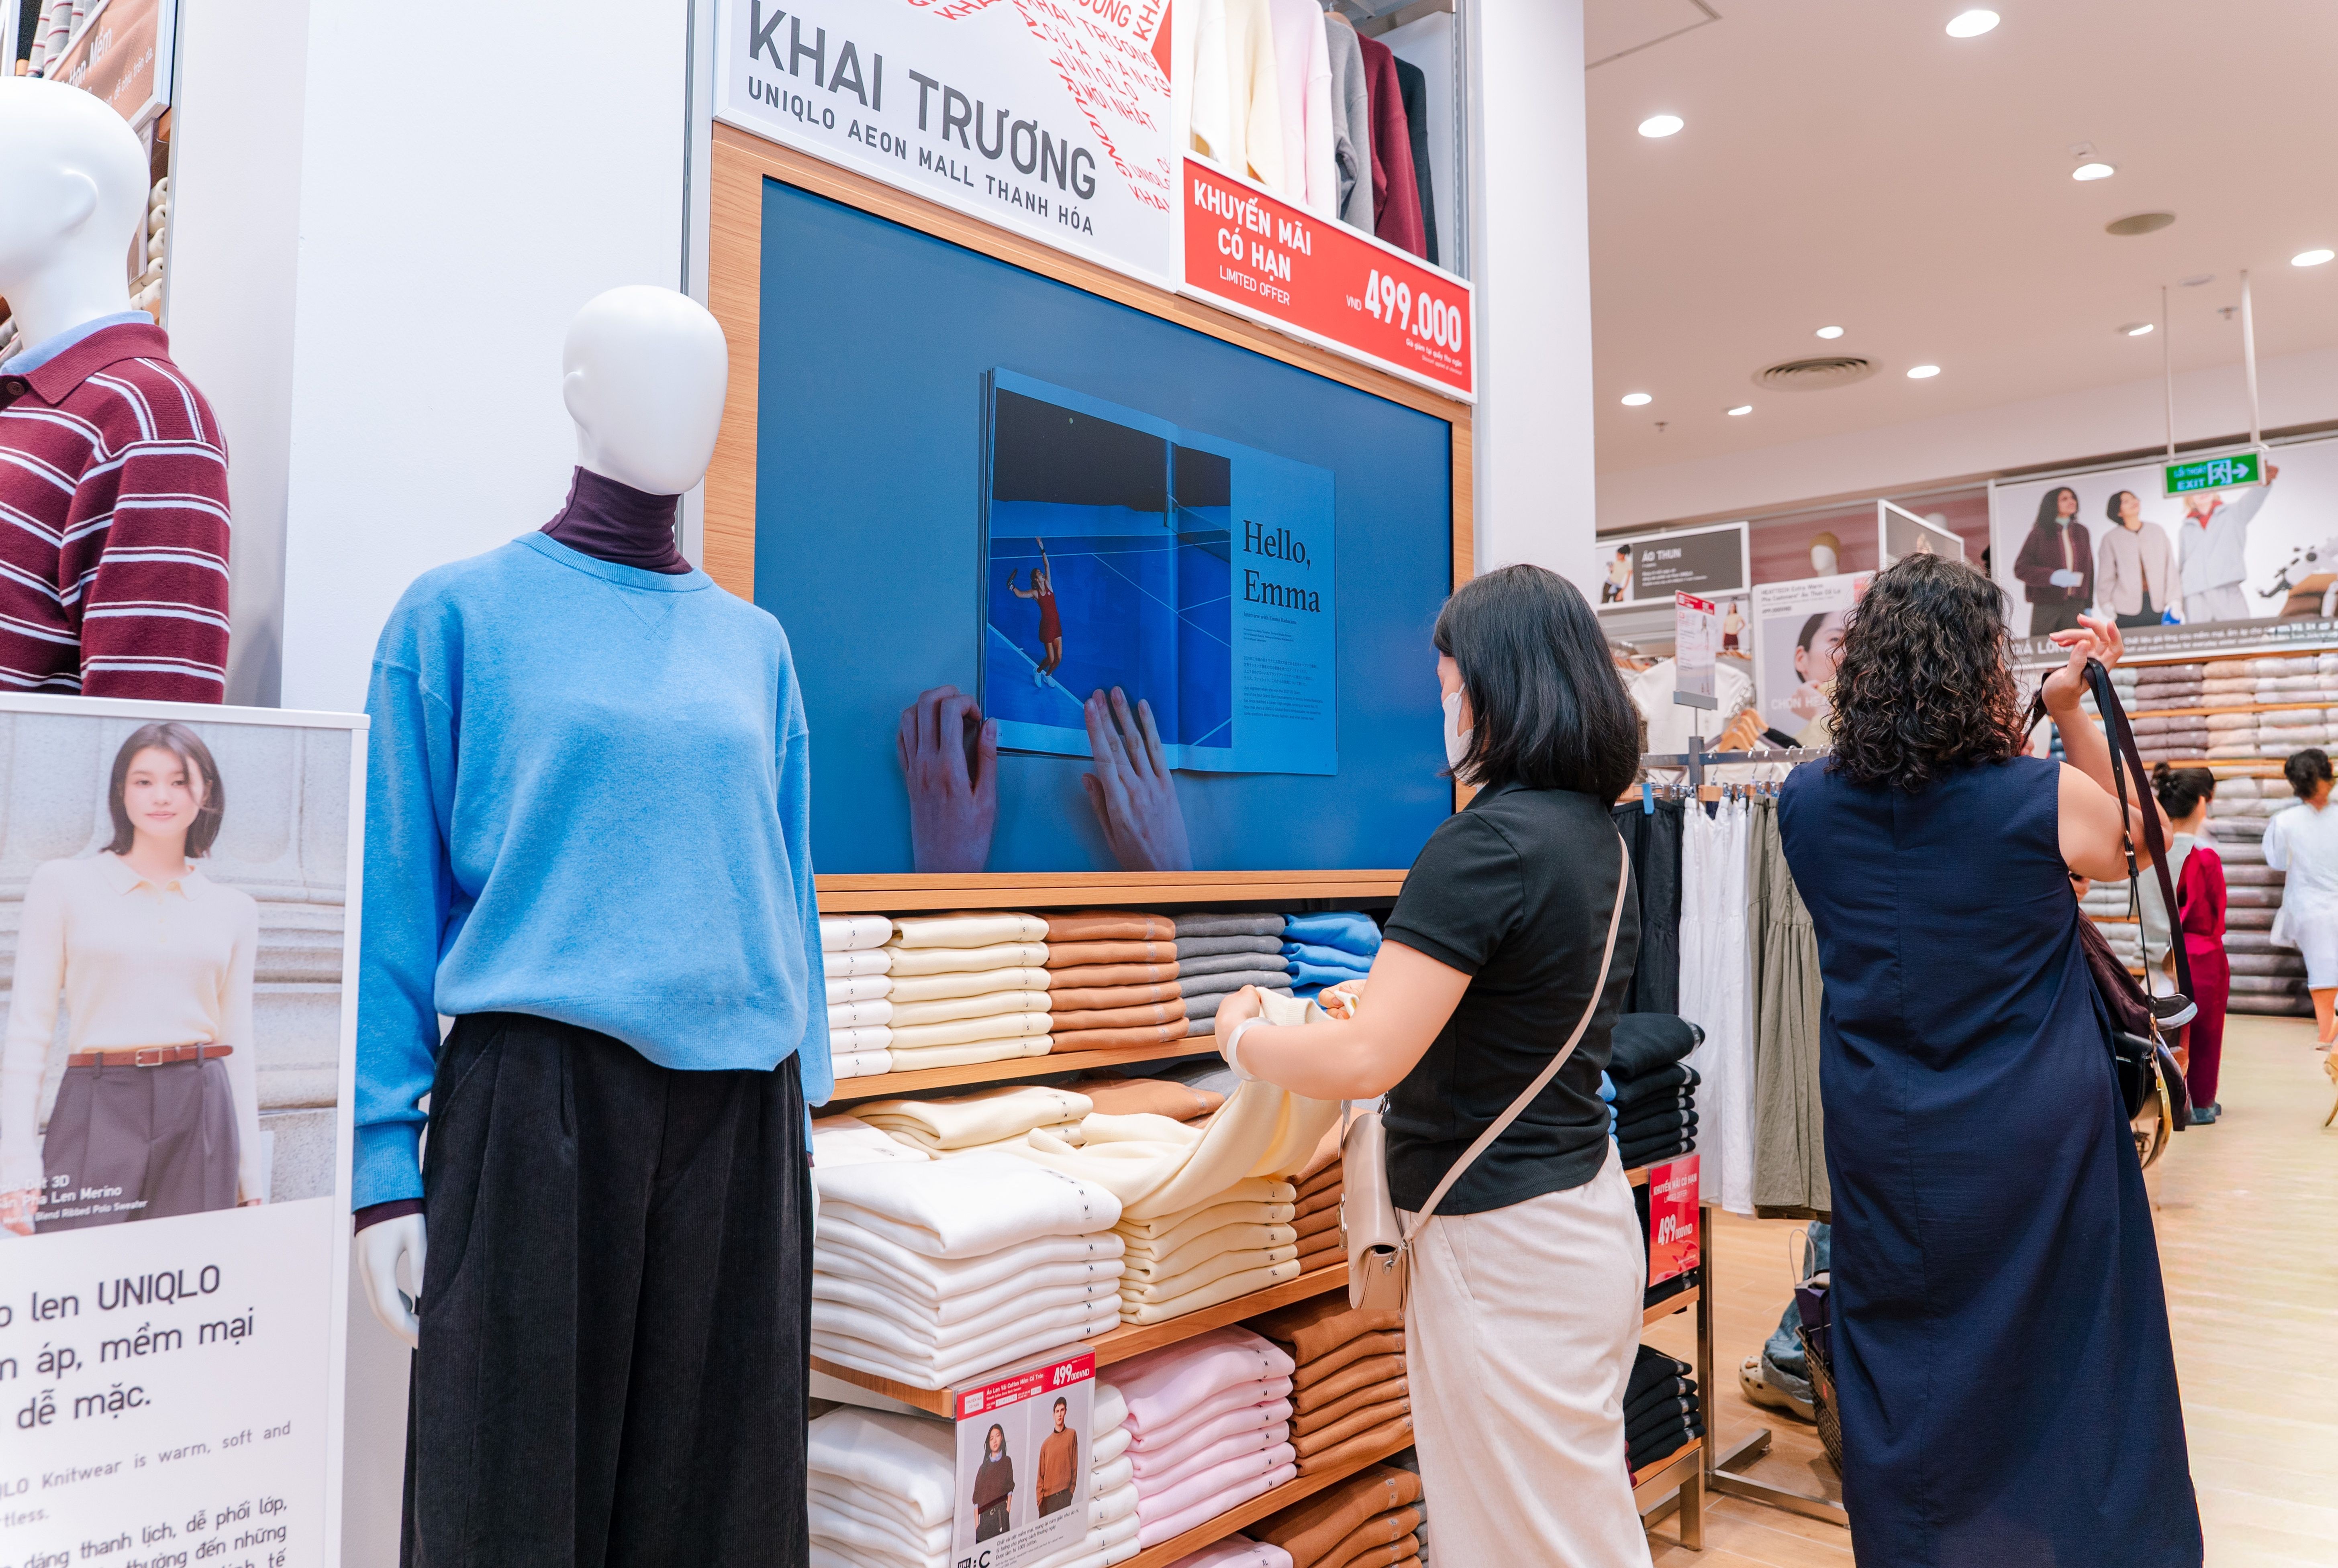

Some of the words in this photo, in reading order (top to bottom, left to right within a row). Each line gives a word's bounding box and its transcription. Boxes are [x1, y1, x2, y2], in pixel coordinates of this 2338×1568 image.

[749, 0, 882, 112] KHAI
[909, 69, 1096, 200] TRƯƠNG
[1058, 49, 1138, 101] UNIQLO
[748, 76, 835, 130] UNIQLO
[848, 119, 907, 160] AEON
[919, 147, 974, 188] MALL
[986, 174, 1048, 218] THANH
[1059, 205, 1093, 237] HÓA
[1194, 179, 1271, 238] KHUYẾN
[1278, 218, 1311, 257] MÃI
[1218, 227, 1244, 261] CÓ
[1251, 241, 1290, 282] HẠN
[1219, 265, 1256, 292] LIMITED
[1260, 282, 1290, 306] OFFER
[1346, 294, 1362, 312] VND
[1365, 269, 1462, 353] 499.000
[2177, 478, 2206, 491] EXIT
[1243, 519, 1311, 571] Hello,
[1656, 548, 1682, 561] THUN
[1243, 568, 1321, 613] Emma
[51, 1174, 70, 1188] 3D
[51, 1191, 77, 1204] Len
[80, 1185, 122, 1200] Merino
[32, 1291, 80, 1322] len
[98, 1264, 221, 1312] UNIQLO
[37, 1341, 83, 1379] áp,
[100, 1321, 183, 1364] mềm
[199, 1306, 253, 1346] mại
[17, 1388, 57, 1430] dễ
[74, 1381, 151, 1420] mặc.
[41, 1460, 122, 1490] Knitwear
[134, 1453, 146, 1469] is
[159, 1443, 211, 1463] warm,
[222, 1429, 252, 1449] soft
[263, 1420, 291, 1440] and
[80, 1531, 132, 1560] thanh
[142, 1522, 177, 1548] lịch,
[186, 1509, 207, 1533] dễ
[216, 1500, 251, 1530] phối
[259, 1495, 287, 1516] lớp,
[196, 1537, 226, 1560] đến
[235, 1525, 287, 1550] những
